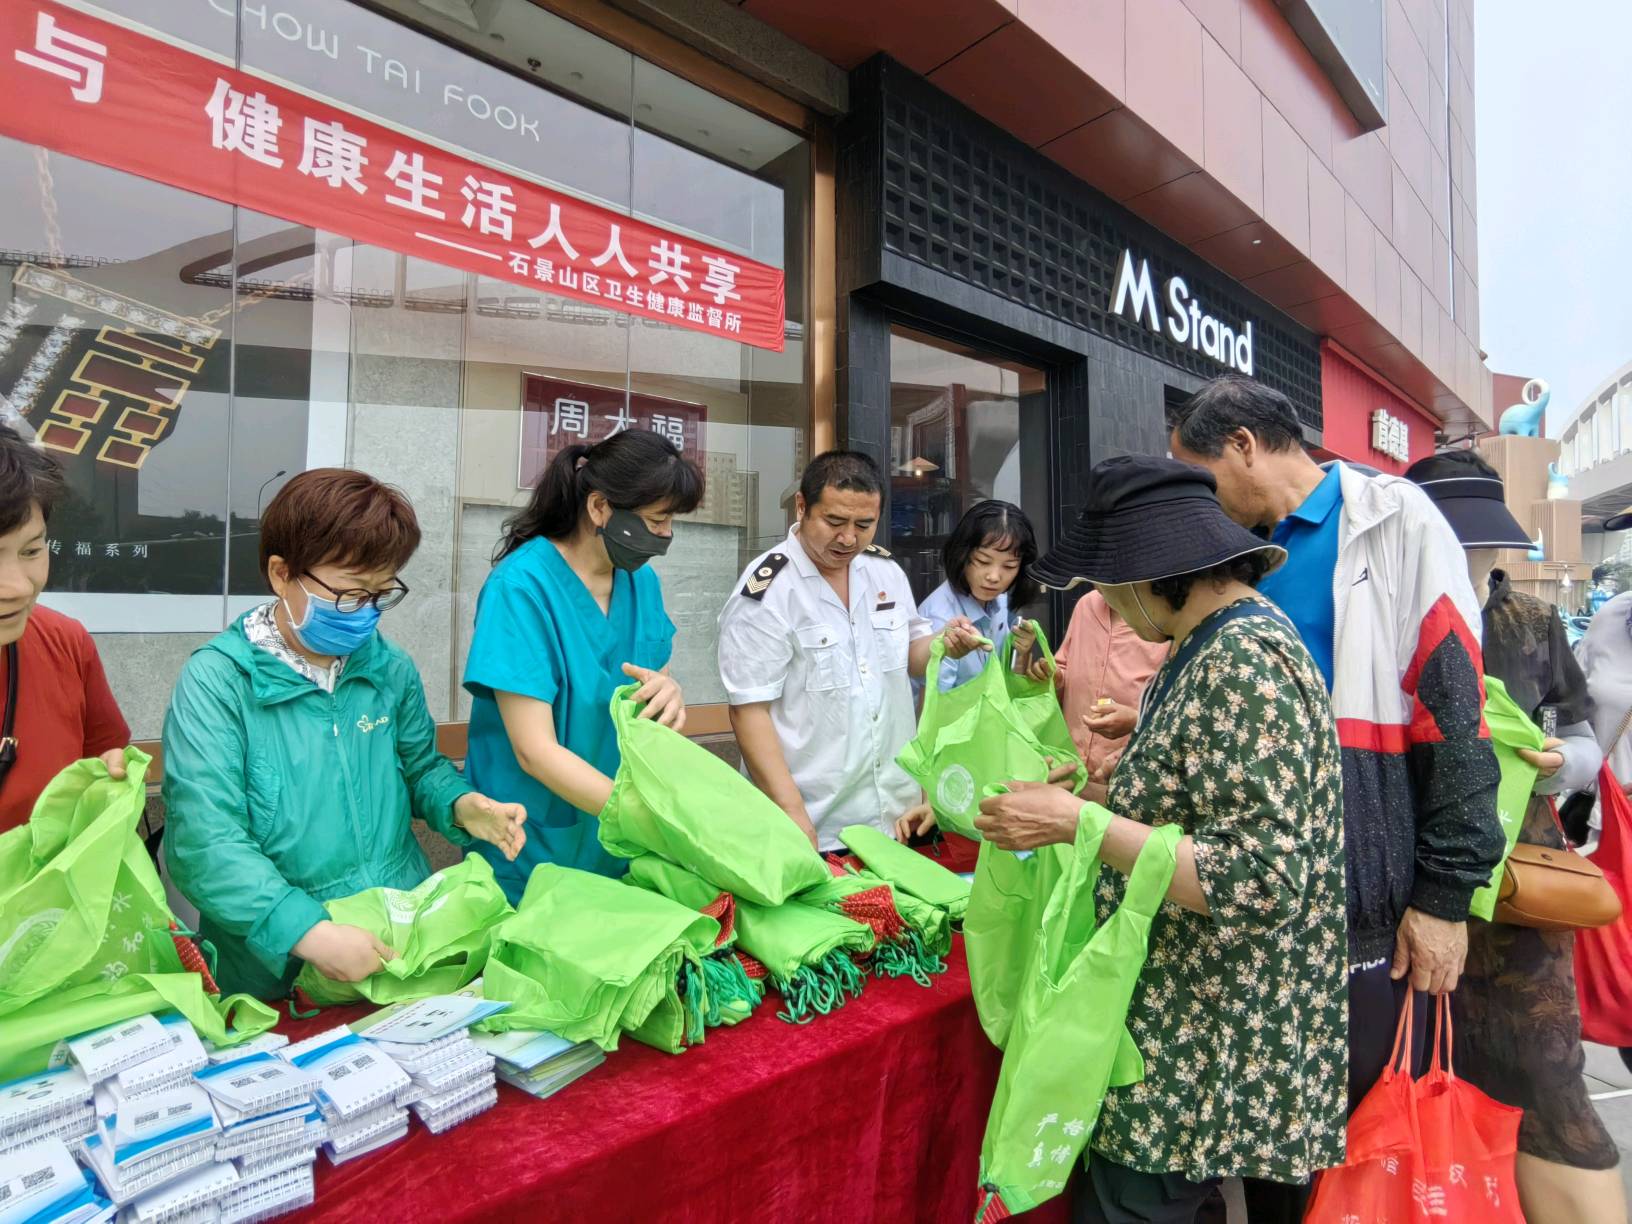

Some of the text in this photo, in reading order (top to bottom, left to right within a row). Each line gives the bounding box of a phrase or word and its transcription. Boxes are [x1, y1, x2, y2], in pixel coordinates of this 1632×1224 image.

[357, 45, 420, 94] TAI
[443, 84, 541, 142] FOOK
[14, 10, 742, 305] 与 健康生活人人共享
[507, 250, 743, 334] 石景山区卫生健康监督所
[1112, 248, 1254, 376] M Stand
